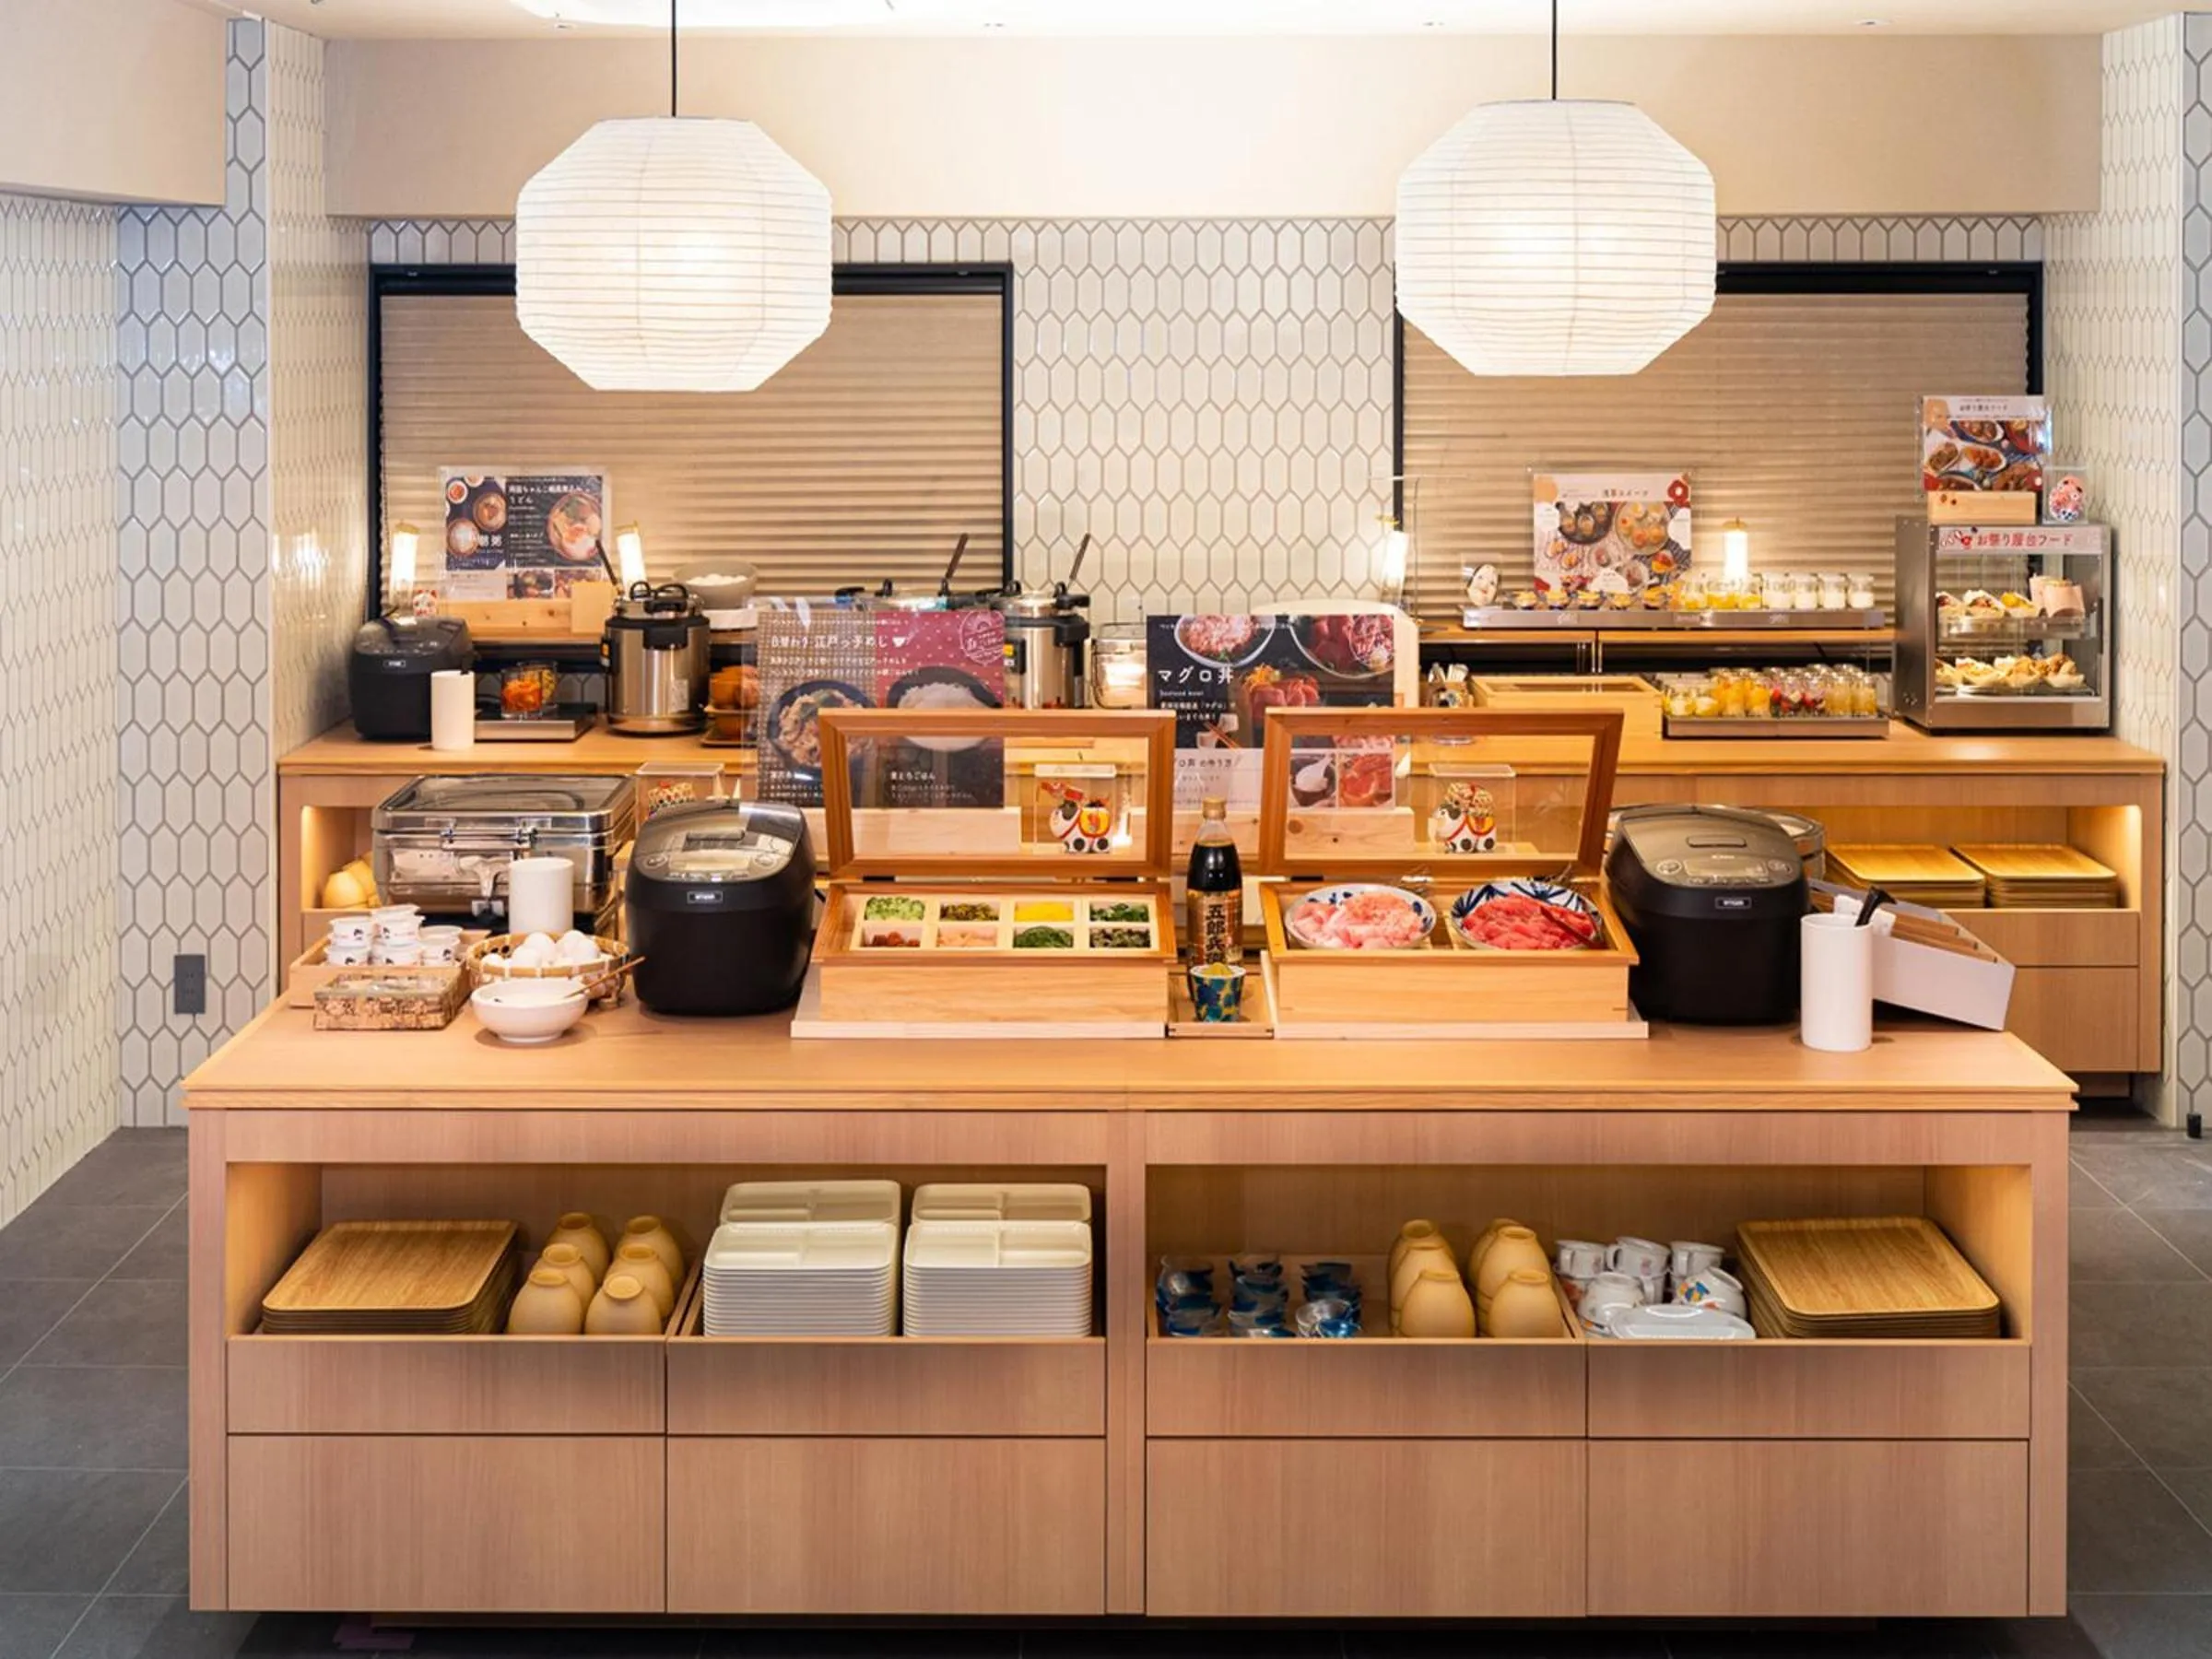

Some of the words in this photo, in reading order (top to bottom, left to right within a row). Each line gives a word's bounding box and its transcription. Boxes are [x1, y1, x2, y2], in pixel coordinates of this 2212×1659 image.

[1977, 533, 2073, 547] お祭り屋台フード
[1158, 665, 1234, 685] マグロ丼
